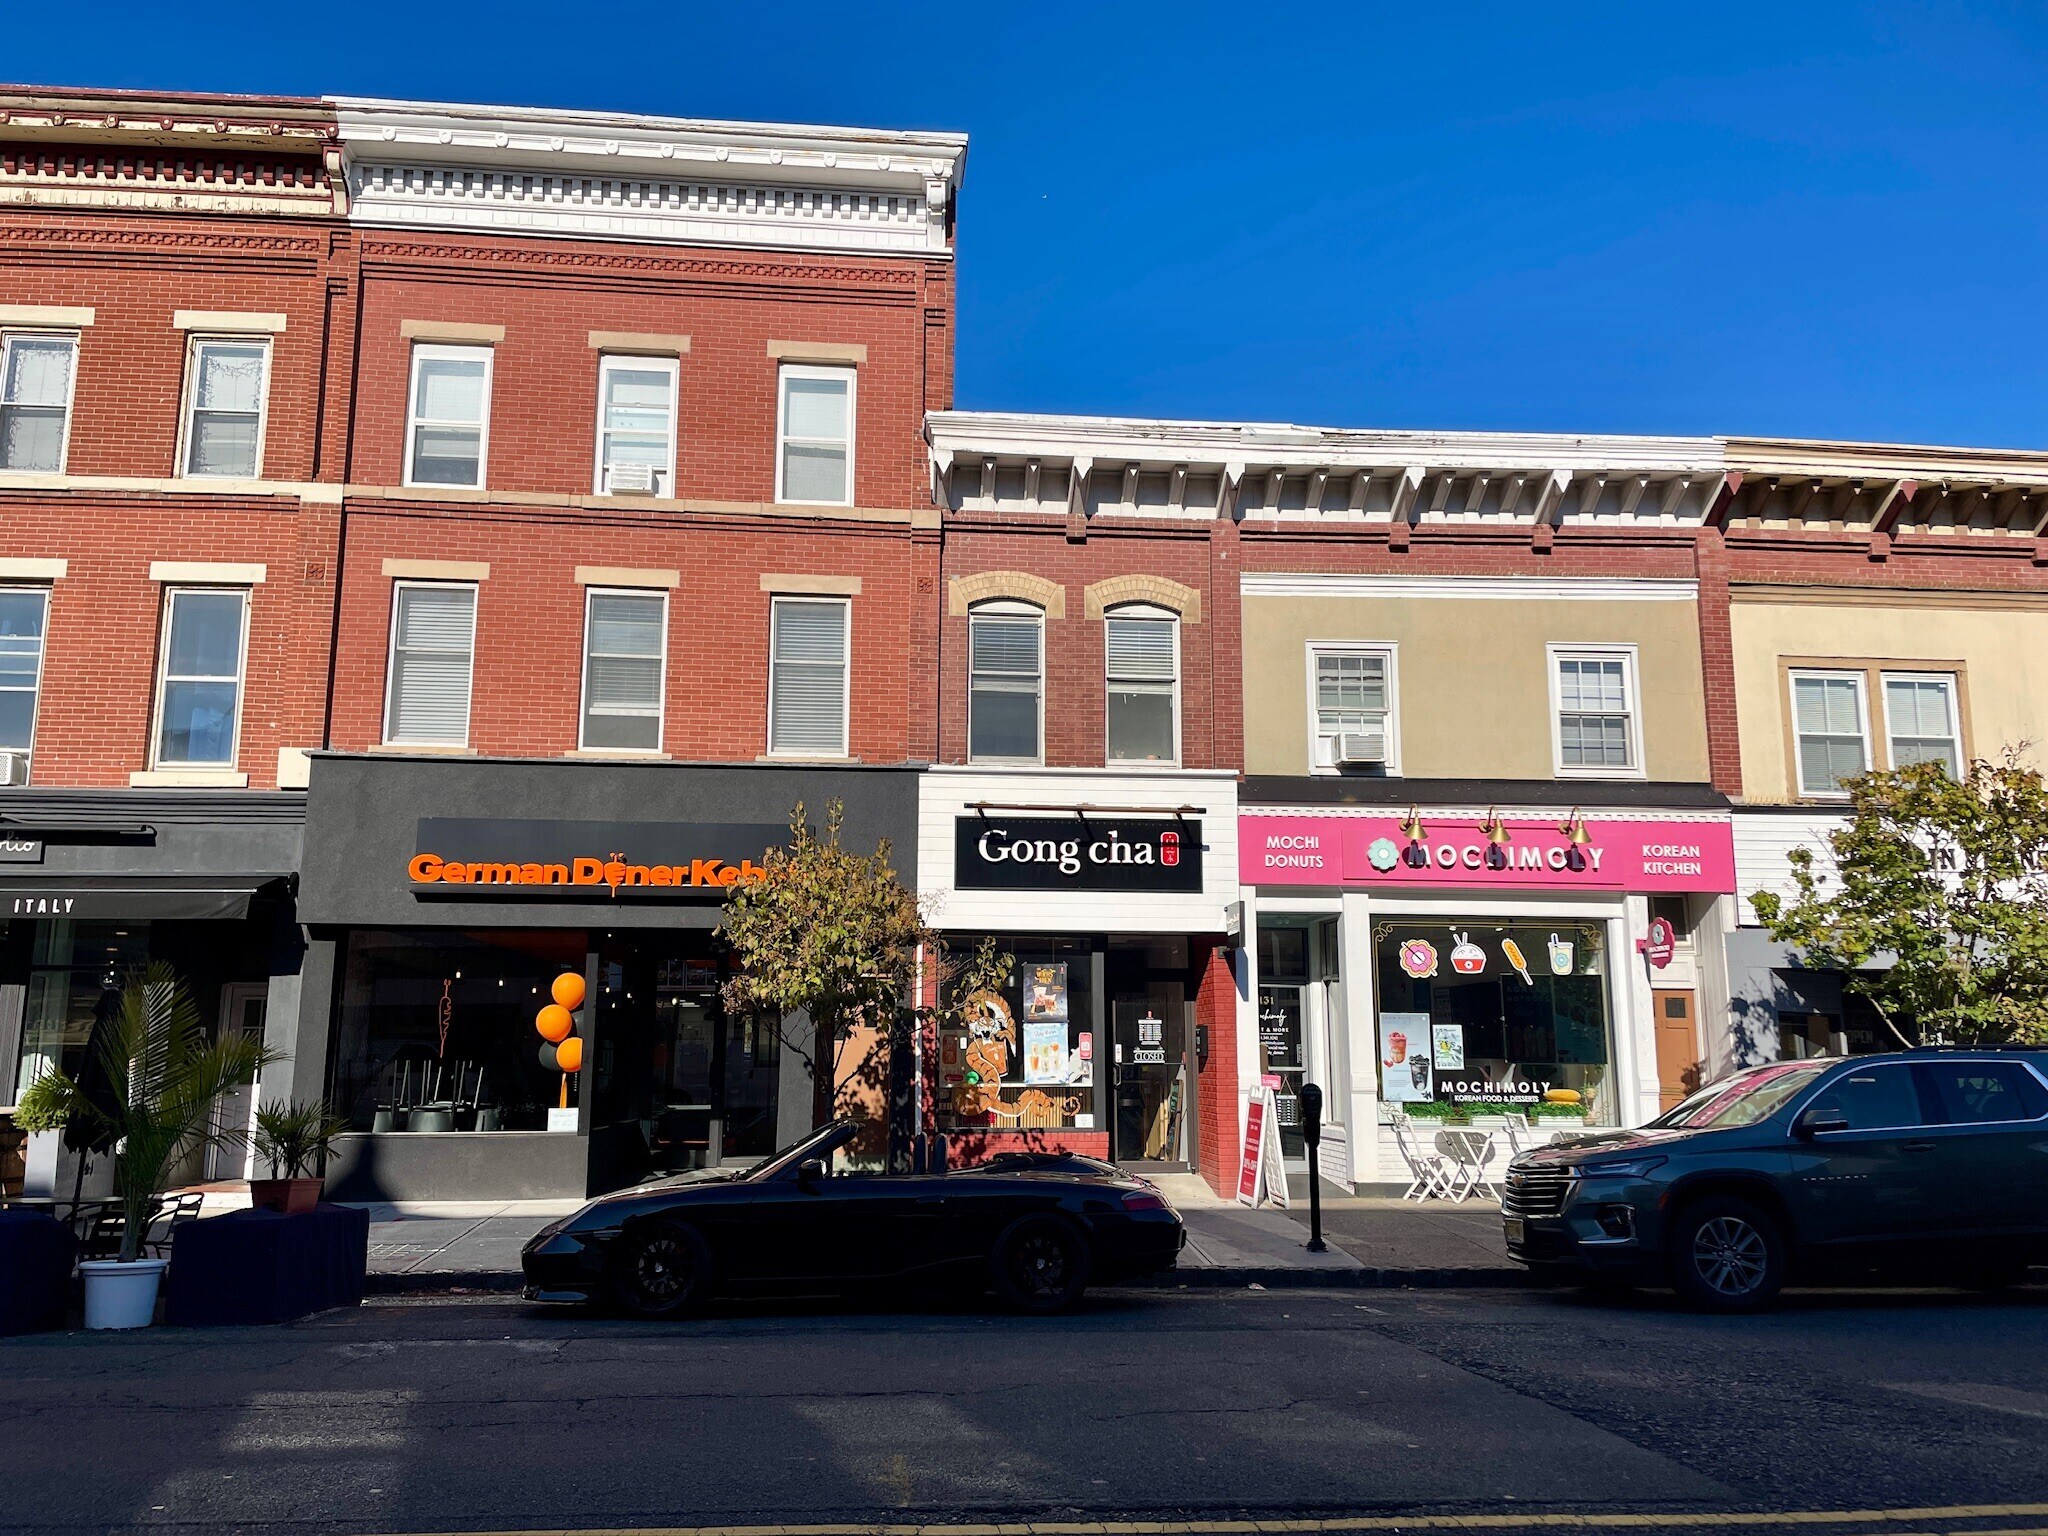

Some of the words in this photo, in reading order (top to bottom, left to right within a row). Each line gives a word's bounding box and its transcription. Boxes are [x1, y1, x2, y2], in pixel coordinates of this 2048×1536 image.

[1266, 835, 1319, 849] MOCHI
[978, 829, 1081, 874] Gong
[1088, 830, 1155, 865] cha
[1408, 843, 1604, 869] MOCHIMOLY
[1642, 844, 1700, 858] KOREAN
[1264, 854, 1324, 868] DONUTS
[1643, 861, 1701, 875] KITCHEN
[408, 853, 568, 884] German
[691, 859, 774, 888] Keb
[14, 898, 74, 913] ITALY
[1134, 1052, 1164, 1061] CLOSED
[1441, 1081, 1551, 1093] MOCHIMOLY
[1510, 1095, 1539, 1103] DESSERTS
